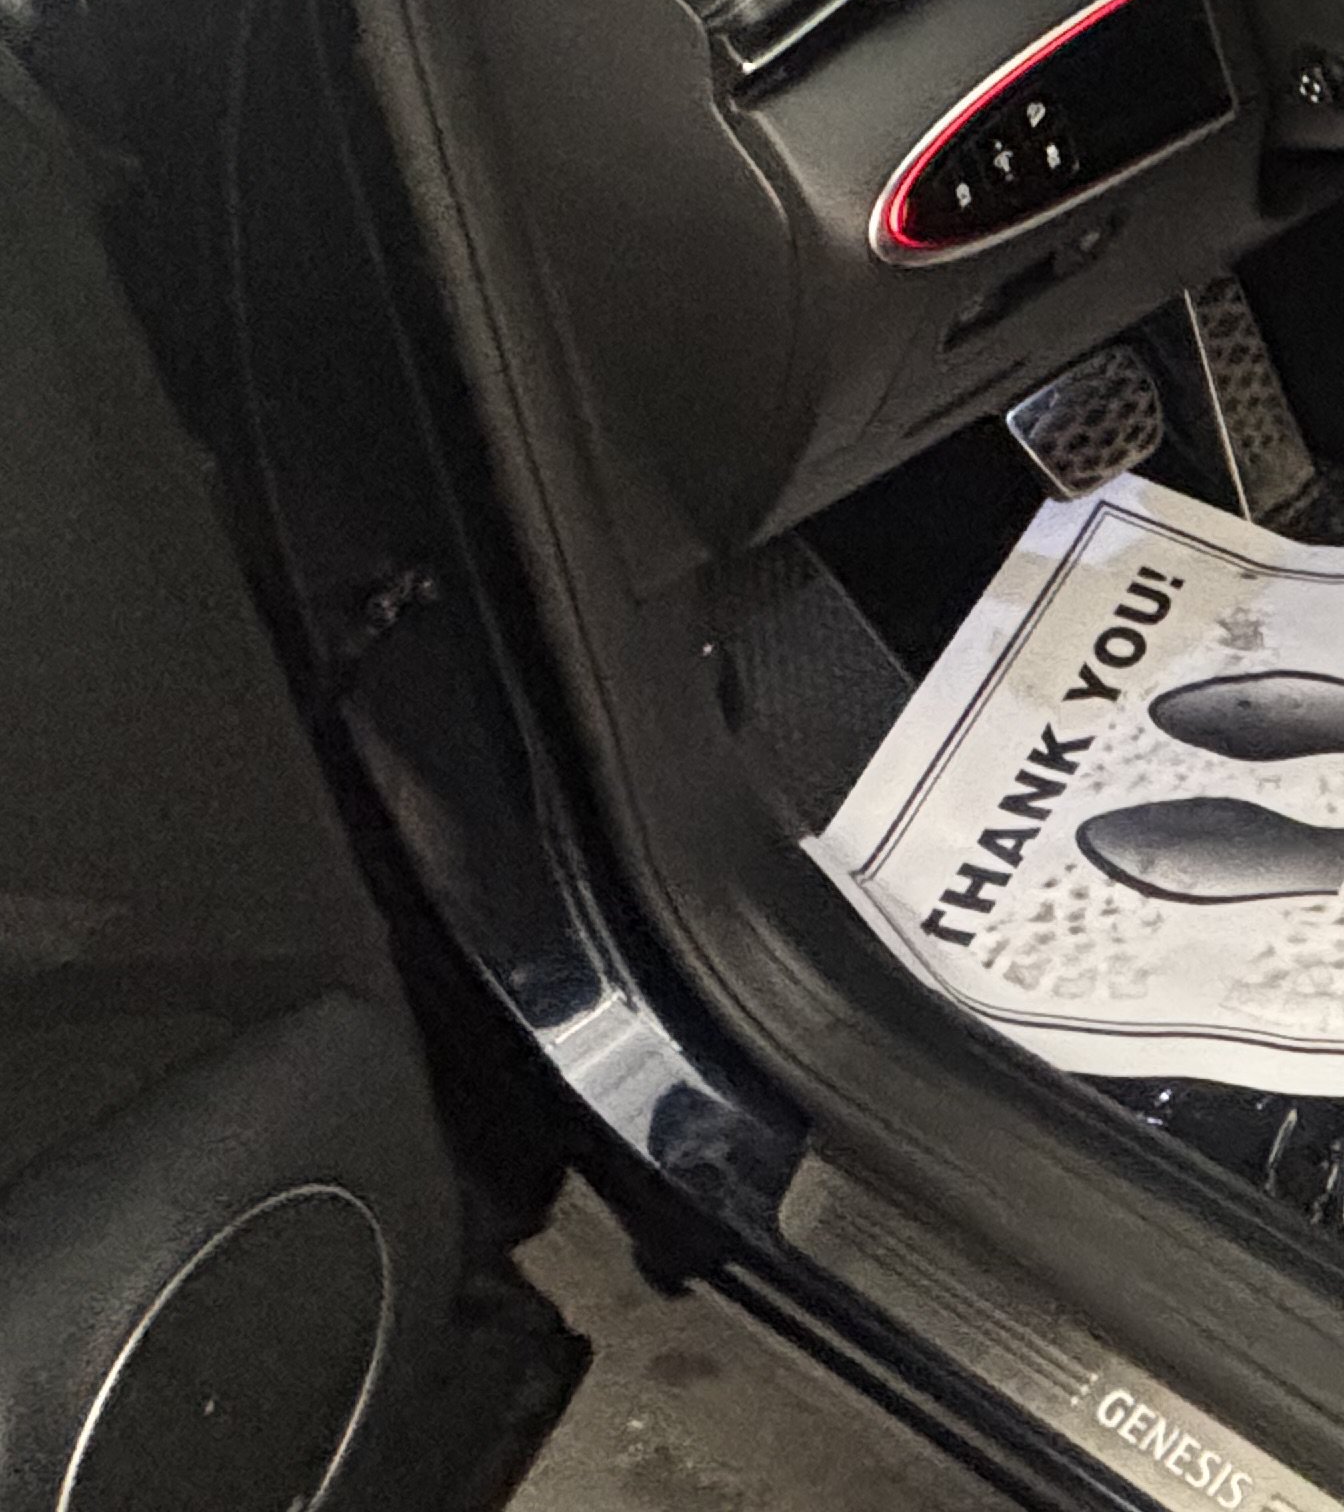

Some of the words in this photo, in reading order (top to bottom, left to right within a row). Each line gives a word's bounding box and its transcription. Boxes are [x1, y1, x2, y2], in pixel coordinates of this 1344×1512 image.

[920, 721, 1096, 947] THANK
[1063, 566, 1185, 702] YOU!
[1096, 1388, 1252, 1510] GENESIS
